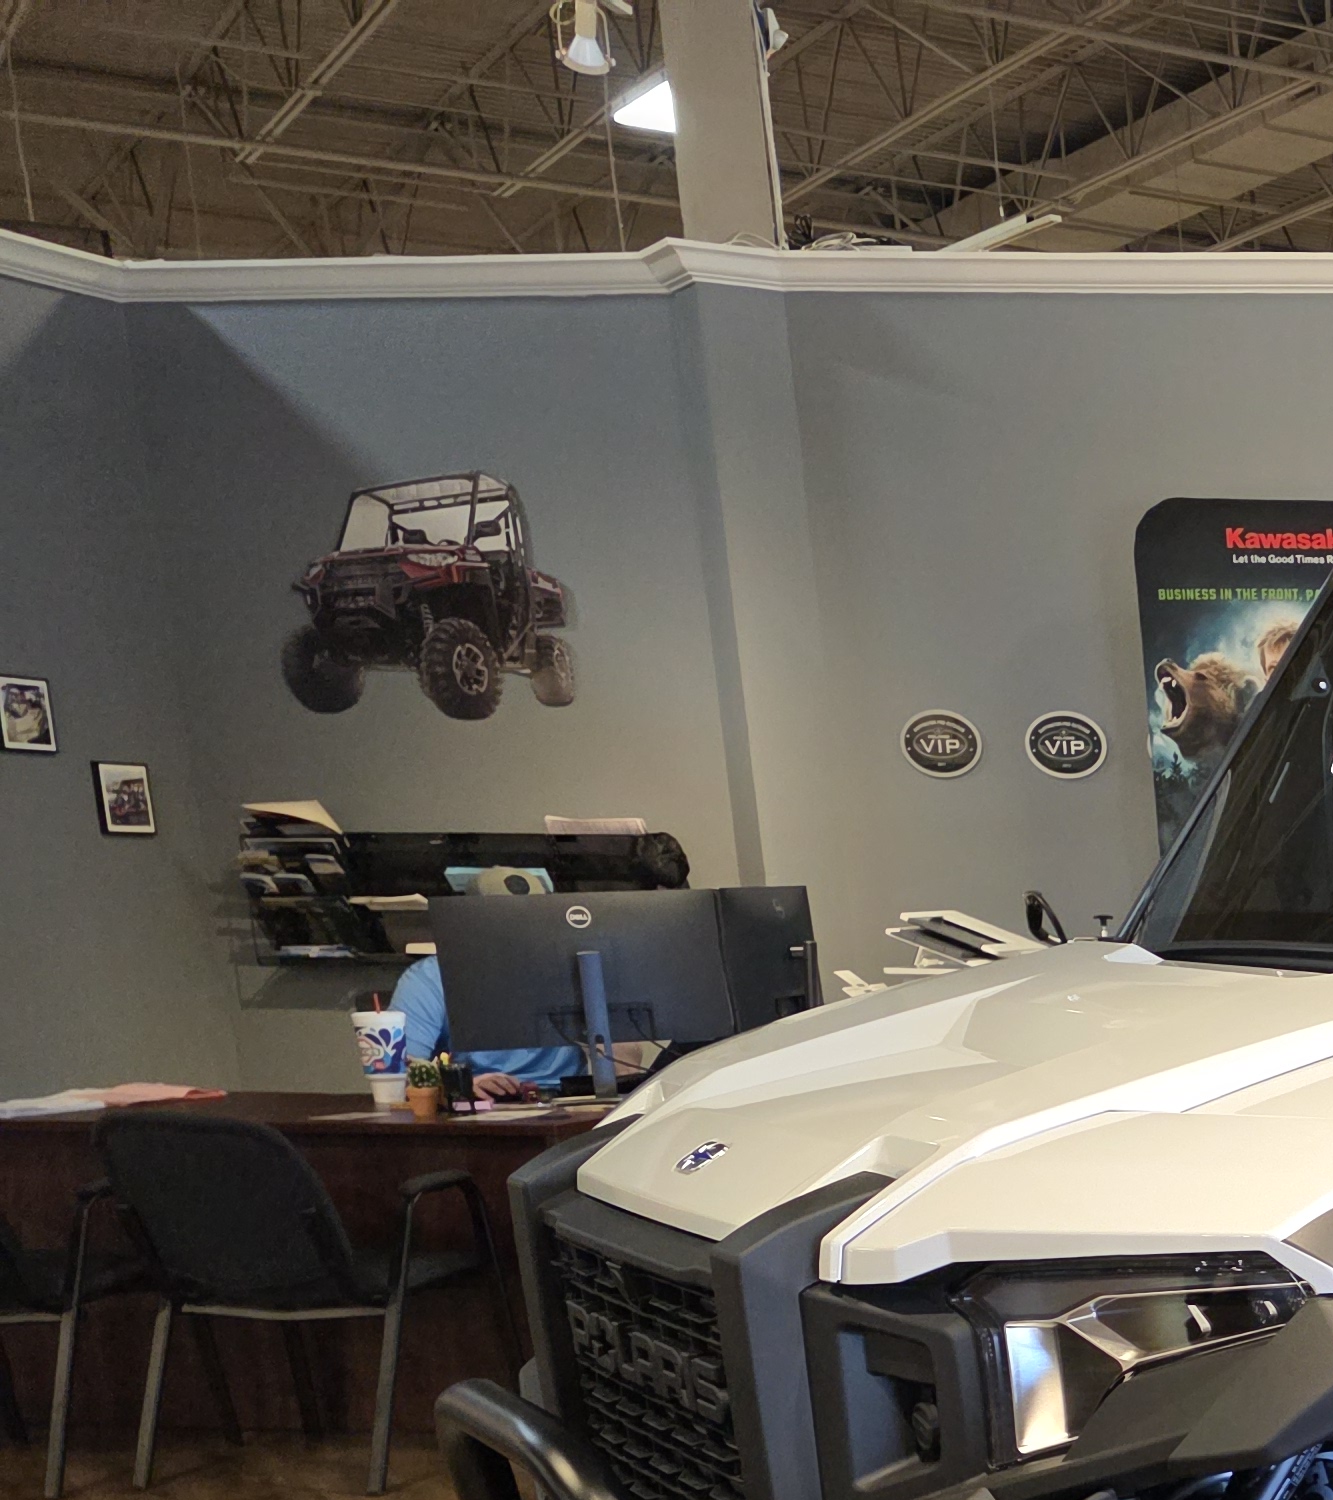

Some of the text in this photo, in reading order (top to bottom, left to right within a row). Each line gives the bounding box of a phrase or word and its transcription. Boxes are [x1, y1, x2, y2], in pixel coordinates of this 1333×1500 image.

[1232, 554, 1248, 564] Let
[1250, 554, 1267, 564] the
[1267, 554, 1294, 564] Good
[1295, 554, 1325, 564] Times
[1158, 588, 1217, 600] BUSINESS
[1220, 588, 1232, 600] IN
[1236, 588, 1258, 600] THE
[919, 738, 960, 754] VIP
[1044, 739, 1085, 755] VIP
[566, 1300, 729, 1425] POLARIS
